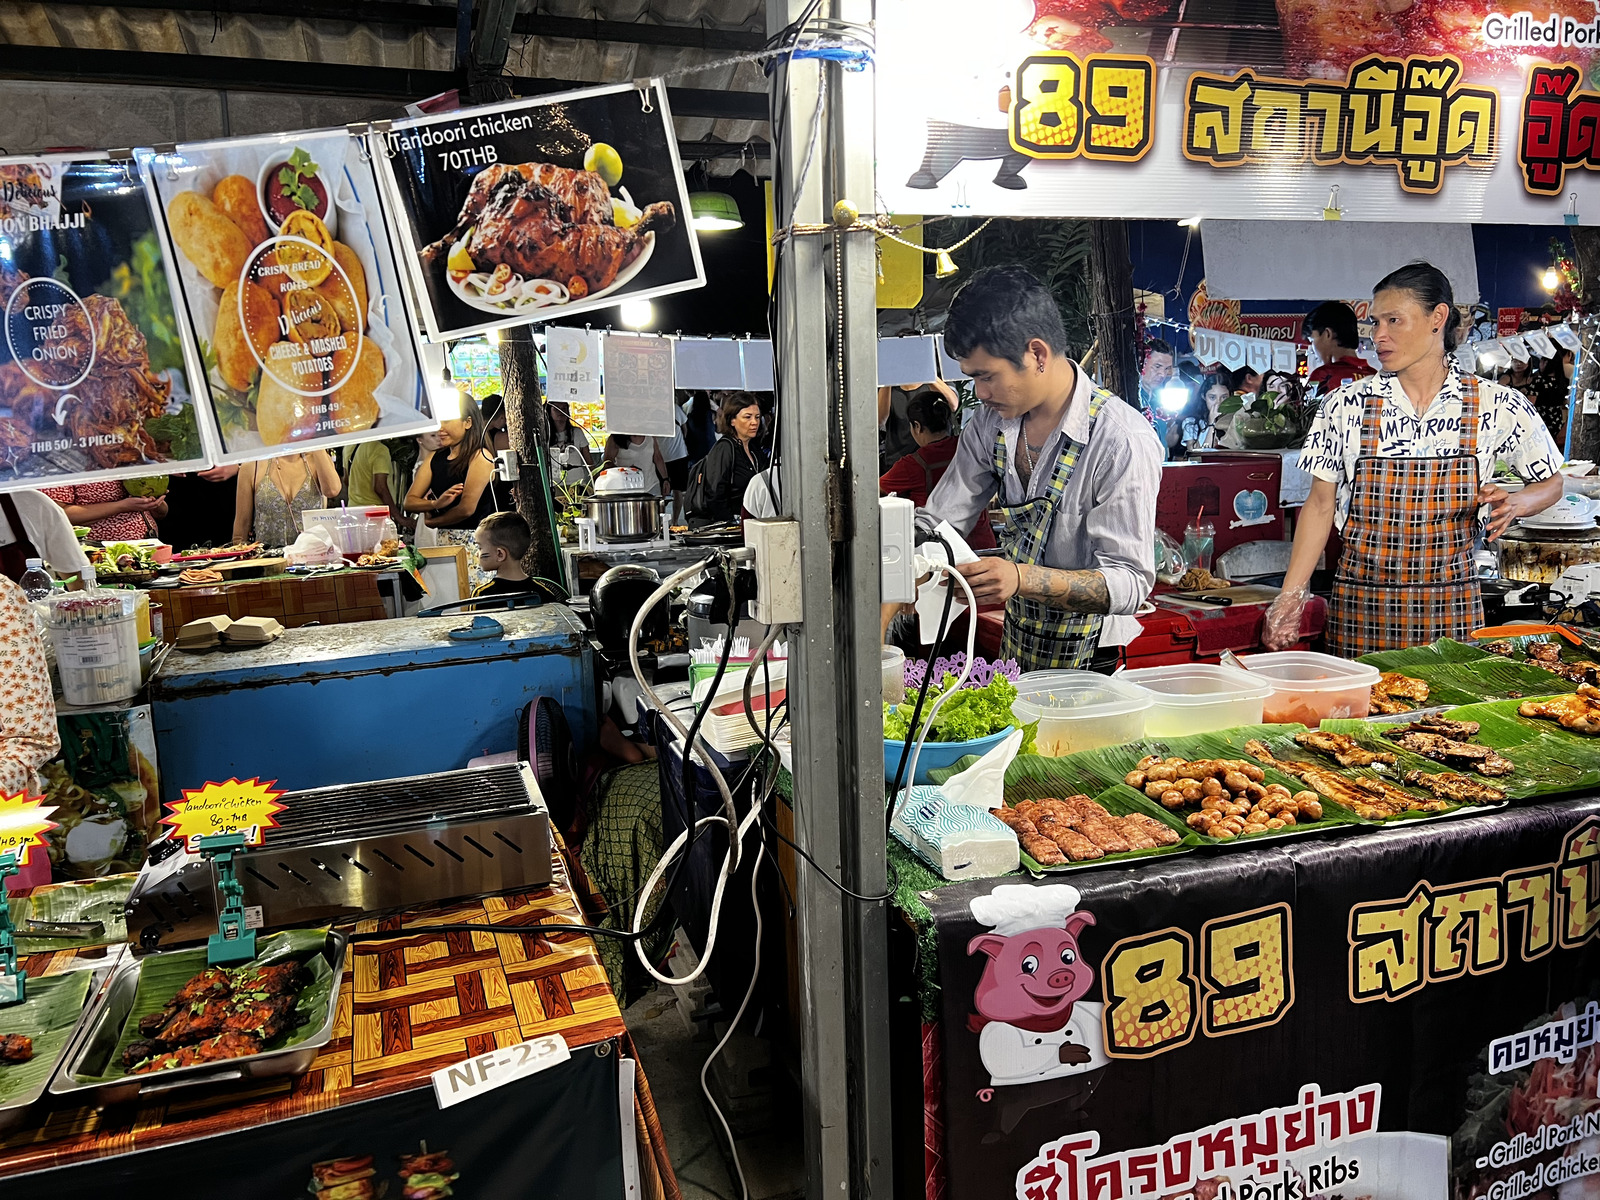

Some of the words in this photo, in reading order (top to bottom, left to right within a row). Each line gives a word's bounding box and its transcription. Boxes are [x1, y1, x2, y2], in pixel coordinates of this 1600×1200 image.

[1486, 16, 1556, 42] Grilled
[1014, 56, 1151, 156] 89
[389, 125, 467, 153] Tandoori
[469, 113, 533, 139] chicken
[438, 145, 498, 172] 70THB
[3, 178, 57, 202] Delicious
[29, 212, 85, 232] BHAJJI
[257, 264, 291, 277] CRISPY
[291, 259, 321, 272] BREAD
[280, 281, 308, 293] ROLLS
[24, 303, 67, 321] CRISPY
[33, 324, 67, 341] FRIED
[31, 345, 78, 362] ONION
[269, 343, 302, 360] CHEESE
[303, 343, 309, 355] &
[310, 336, 347, 354] MASHED
[292, 356, 334, 376] POTATOES
[311, 404, 328, 415] THB
[315, 422, 322, 431] 2
[322, 417, 351, 430] PIECES
[31, 441, 53, 454] THB
[79, 437, 86, 448] 3
[88, 433, 125, 447] PIECES
[183, 795, 227, 814] Tandoori
[223, 796, 262, 810] chicken
[1106, 908, 1289, 1053] 89
[447, 1038, 558, 1093] NF-23
[1491, 1128, 1542, 1165] Grilled
[1549, 1118, 1580, 1147] Pork
[1309, 1156, 1359, 1193] Ribs
[1490, 1165, 1541, 1200] Grilled
